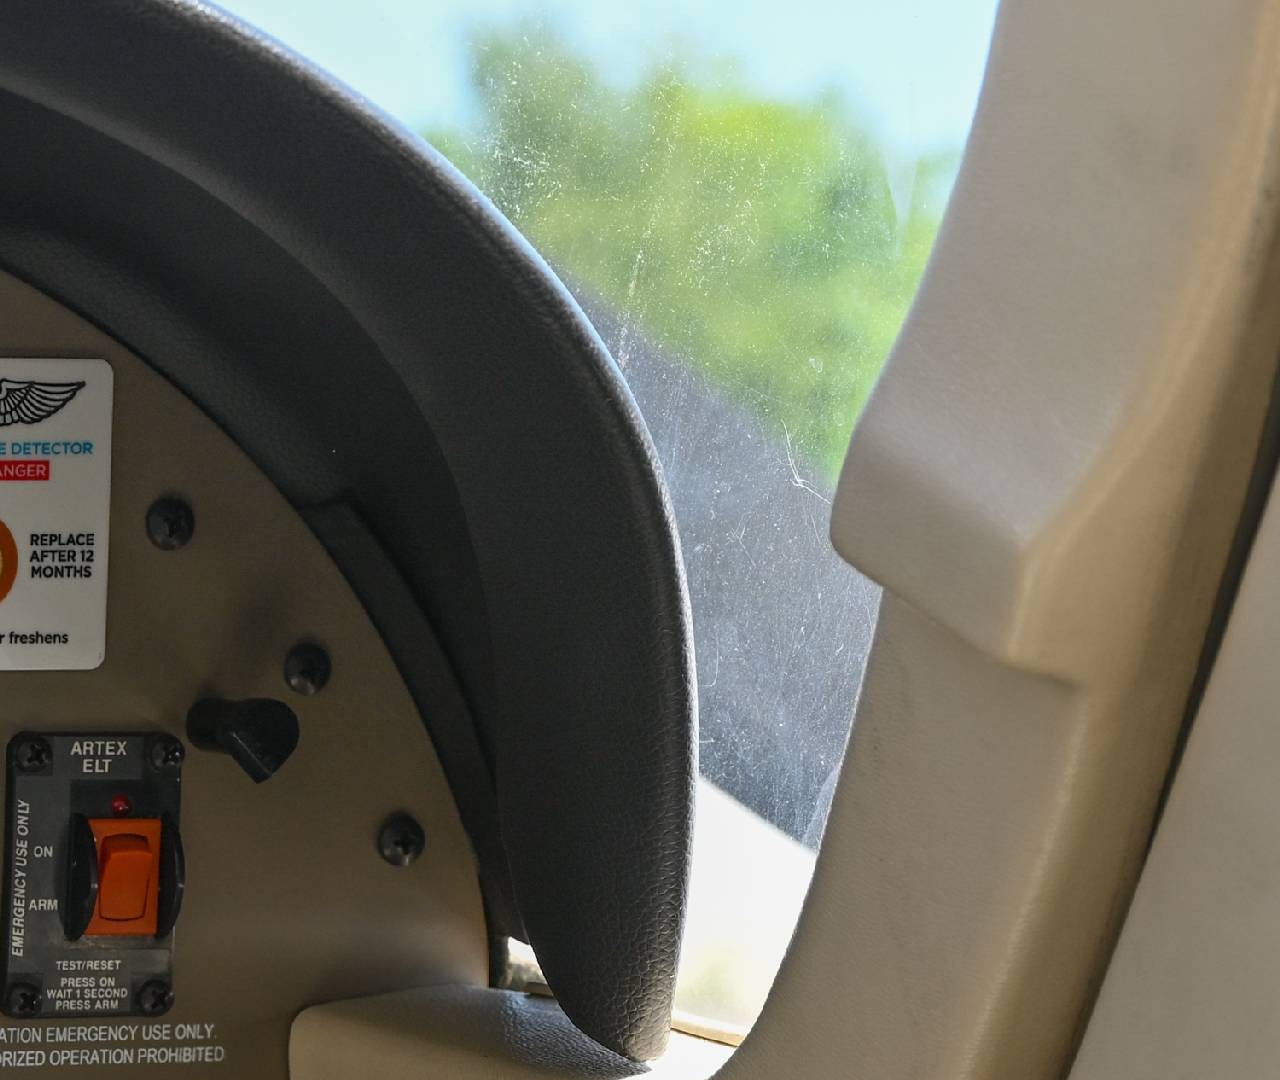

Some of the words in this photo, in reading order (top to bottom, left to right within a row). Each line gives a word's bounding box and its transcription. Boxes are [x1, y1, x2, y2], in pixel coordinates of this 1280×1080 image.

[11, 443, 93, 455] DETECTOR
[30, 534, 94, 546] REPLACE
[30, 551, 76, 562] AFTER
[80, 551, 94, 562] 12
[31, 566, 92, 578] MONTHS
[9, 631, 68, 644] freshens
[71, 742, 127, 755] ARTEX
[83, 760, 111, 772] ELT
[18, 800, 30, 836] ONLY
[15, 838, 29, 866] USE
[34, 847, 53, 857] ON
[29, 900, 58, 910] ARM
[12, 868, 27, 957] EMERGENCY
[56, 961, 121, 970] TEST/RESET
[46, 1025, 138, 1042] EMERGENCY
[142, 1025, 170, 1040] USE
[51, 1049, 133, 1066] OPERATION
[138, 1047, 224, 1063] PROHIBITED
